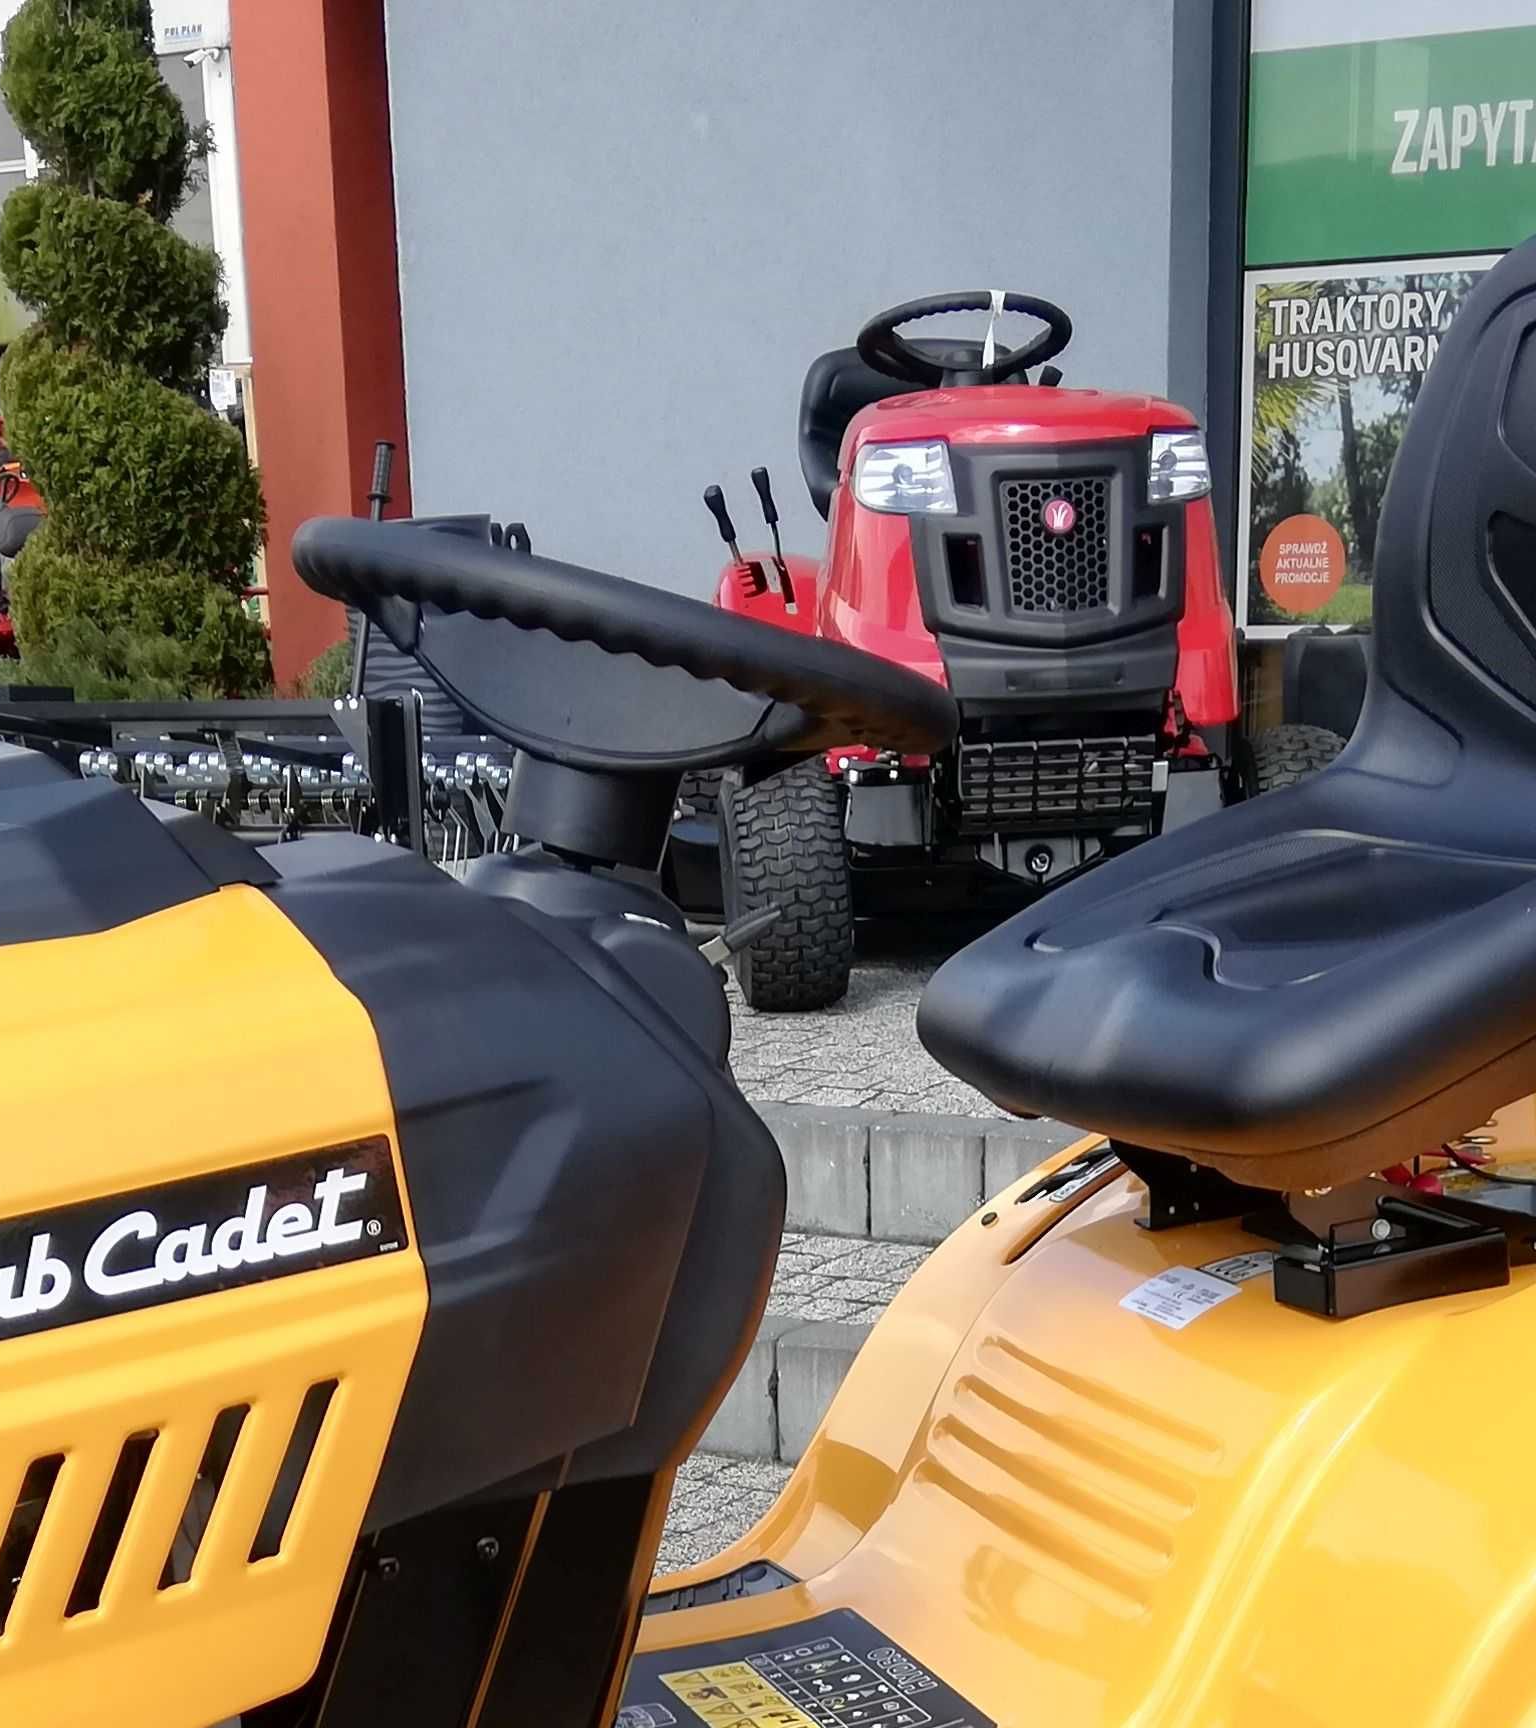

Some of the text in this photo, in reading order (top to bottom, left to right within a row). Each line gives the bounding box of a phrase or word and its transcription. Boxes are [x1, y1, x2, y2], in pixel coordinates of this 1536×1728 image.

[1268, 290, 1447, 336] TRAKTORY
[1279, 541, 1328, 555] SPRAWDŹ
[1276, 557, 1329, 569] AKTUALNE
[1274, 571, 1330, 584] PROMOCJE
[83, 1167, 367, 1296] Cadet
